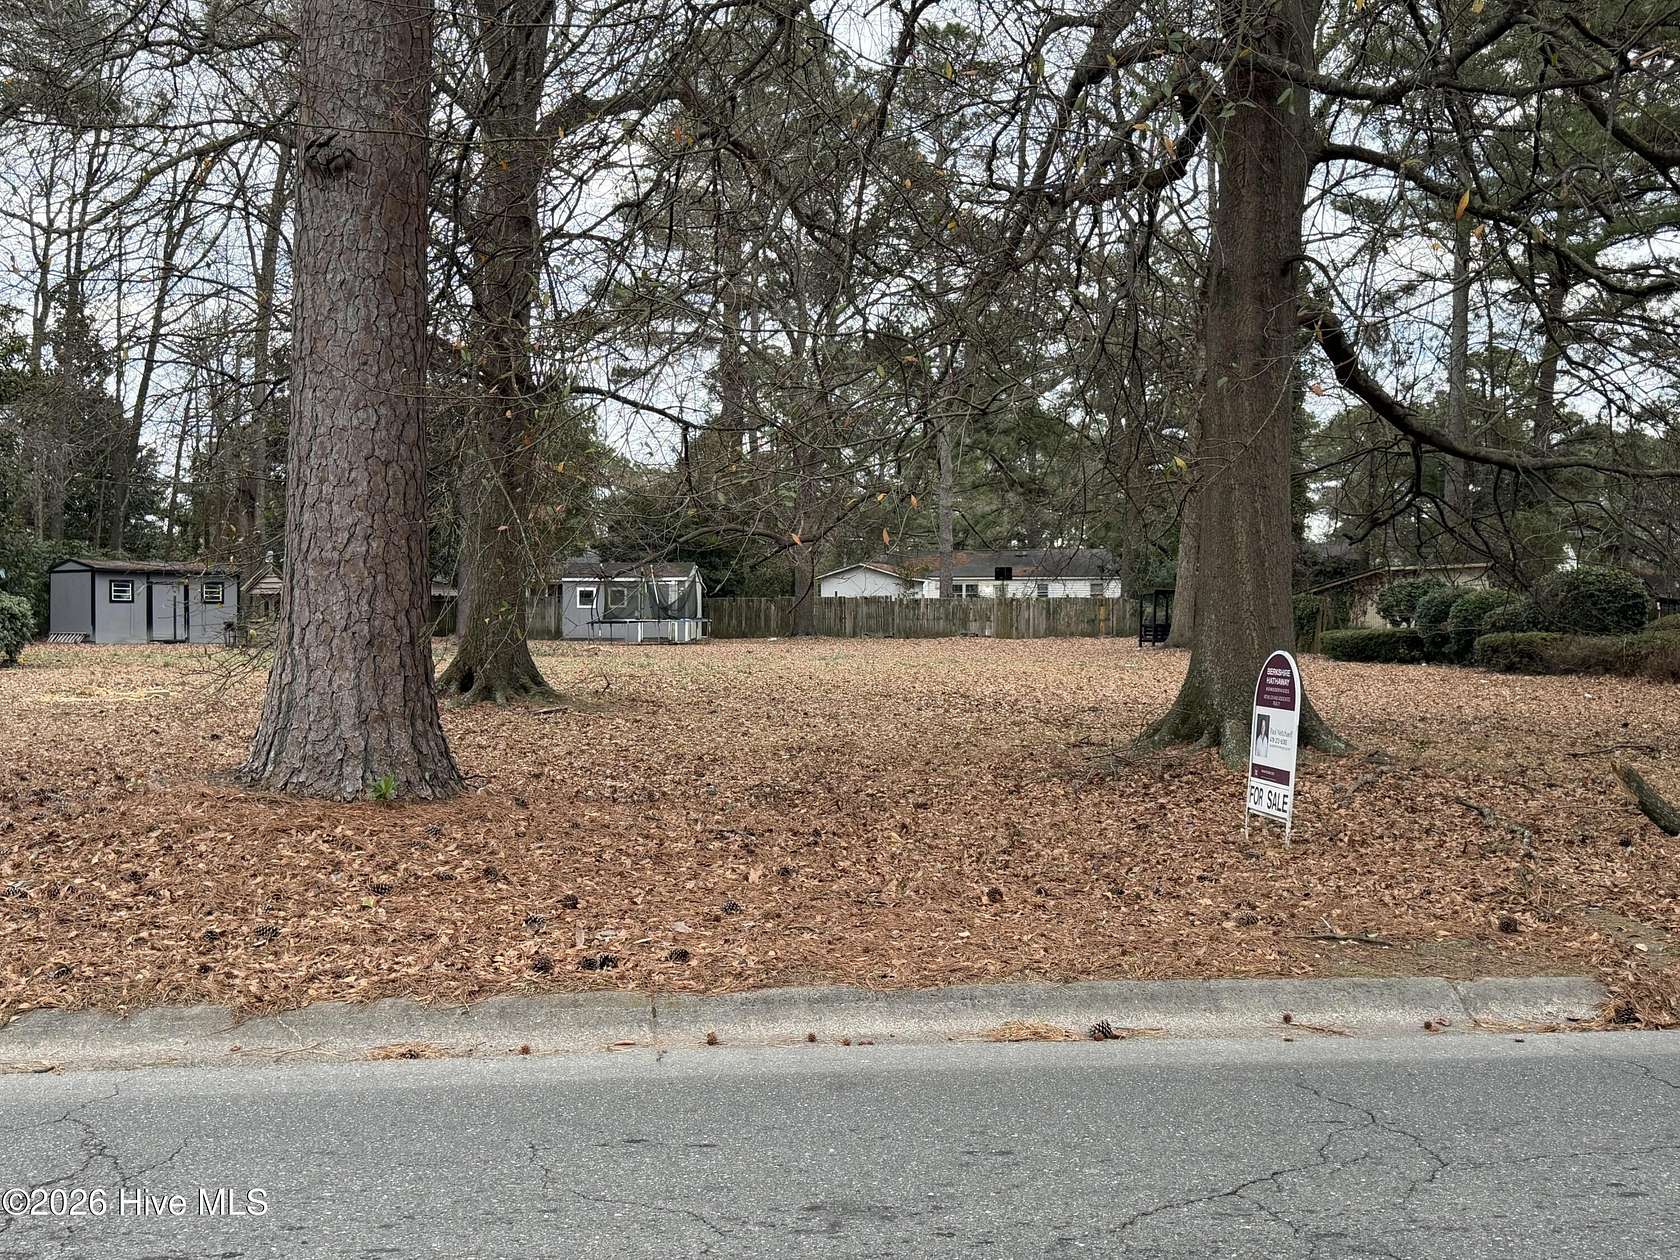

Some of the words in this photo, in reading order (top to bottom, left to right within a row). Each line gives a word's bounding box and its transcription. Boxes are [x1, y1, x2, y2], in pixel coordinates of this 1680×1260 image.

[1267, 667, 1291, 677] BERKSHIRE
[1266, 677, 1290, 686] HATHAWAY
[1249, 786, 1263, 807] FOR
[1267, 790, 1288, 813] SALE
